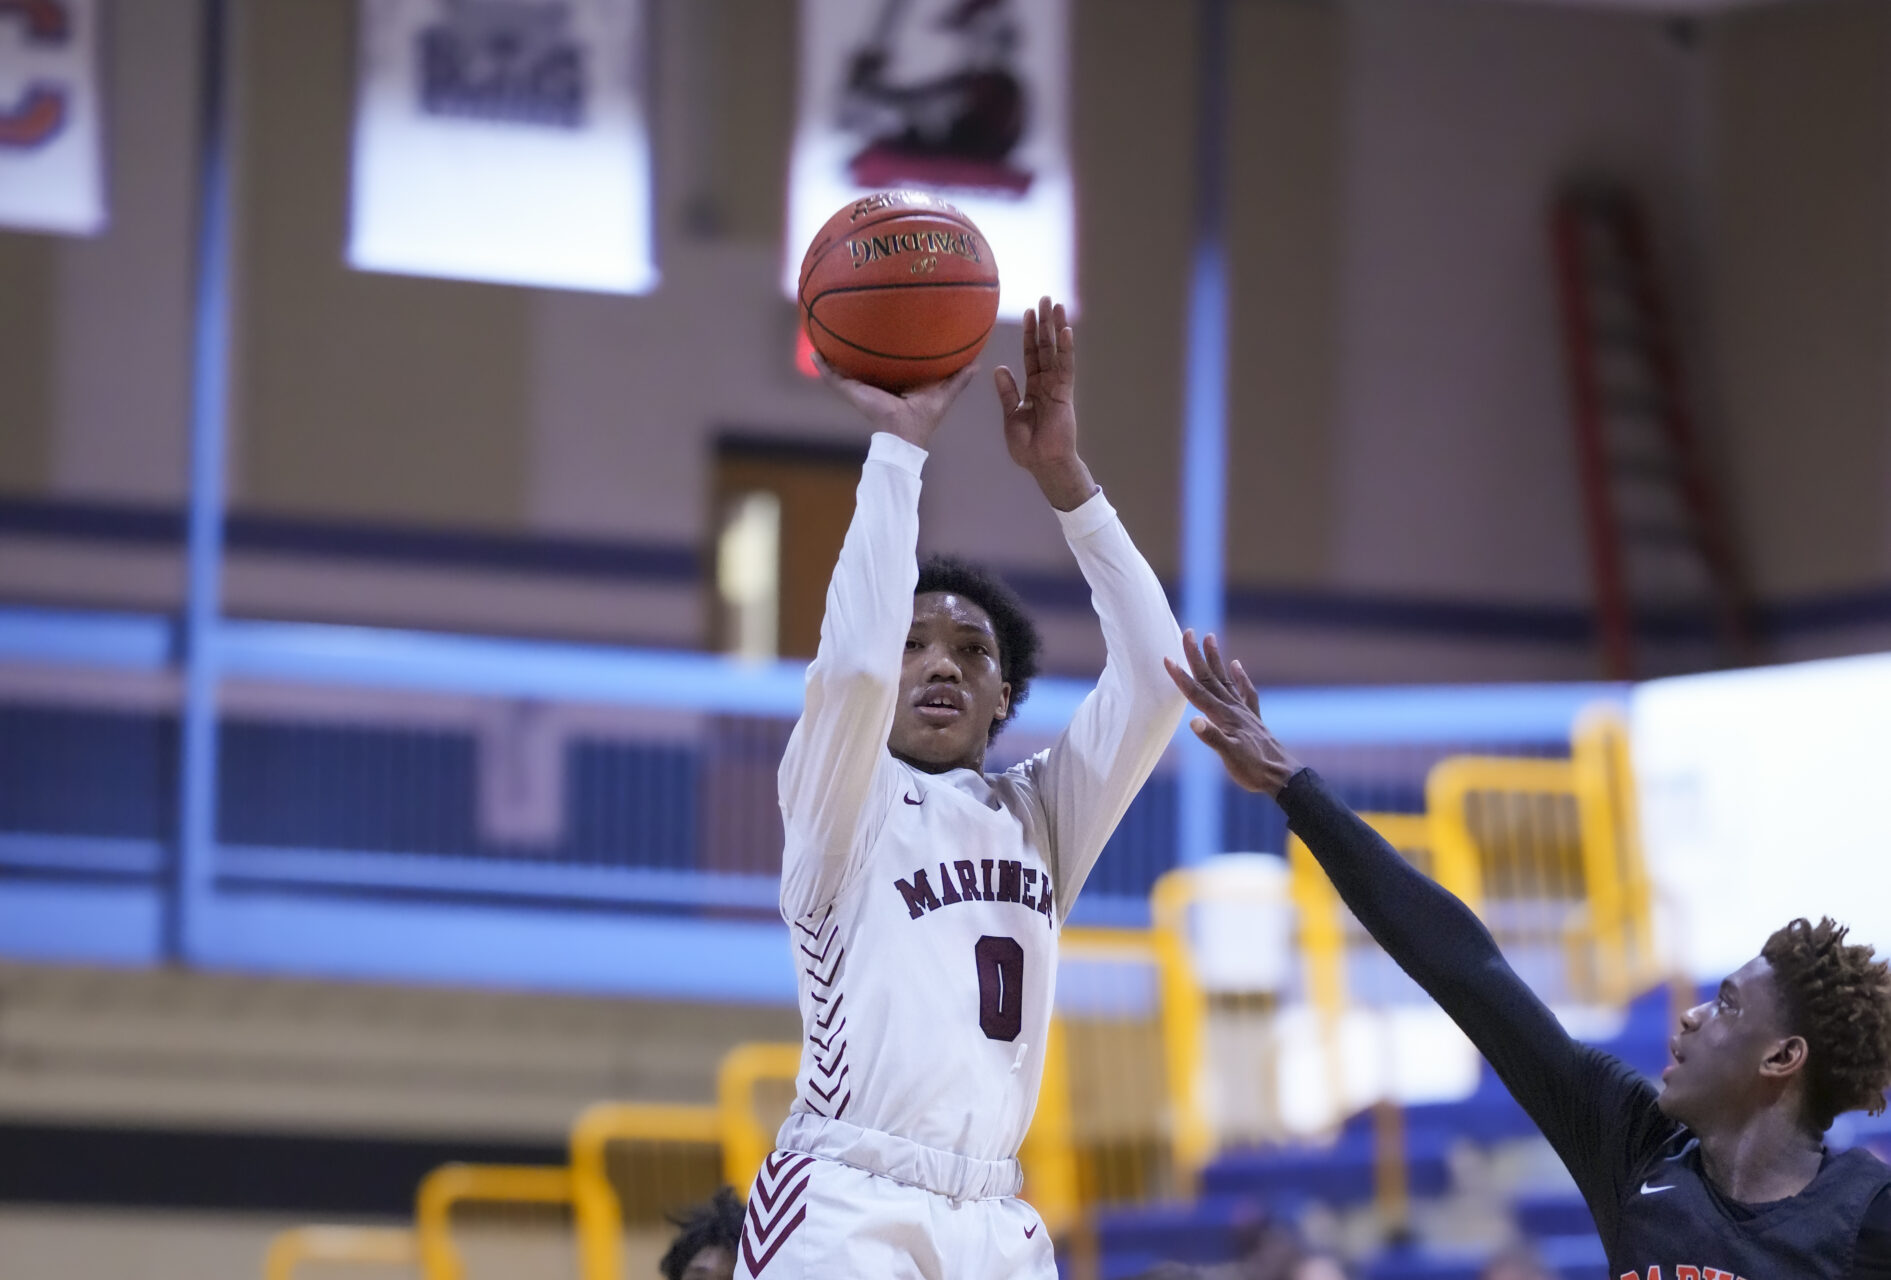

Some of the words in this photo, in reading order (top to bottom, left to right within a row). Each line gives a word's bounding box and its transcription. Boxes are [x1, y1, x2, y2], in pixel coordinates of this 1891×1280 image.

[848, 231, 980, 269] SPALDING
[893, 859, 1053, 930] MARINER
[975, 935, 1024, 1042] 0
